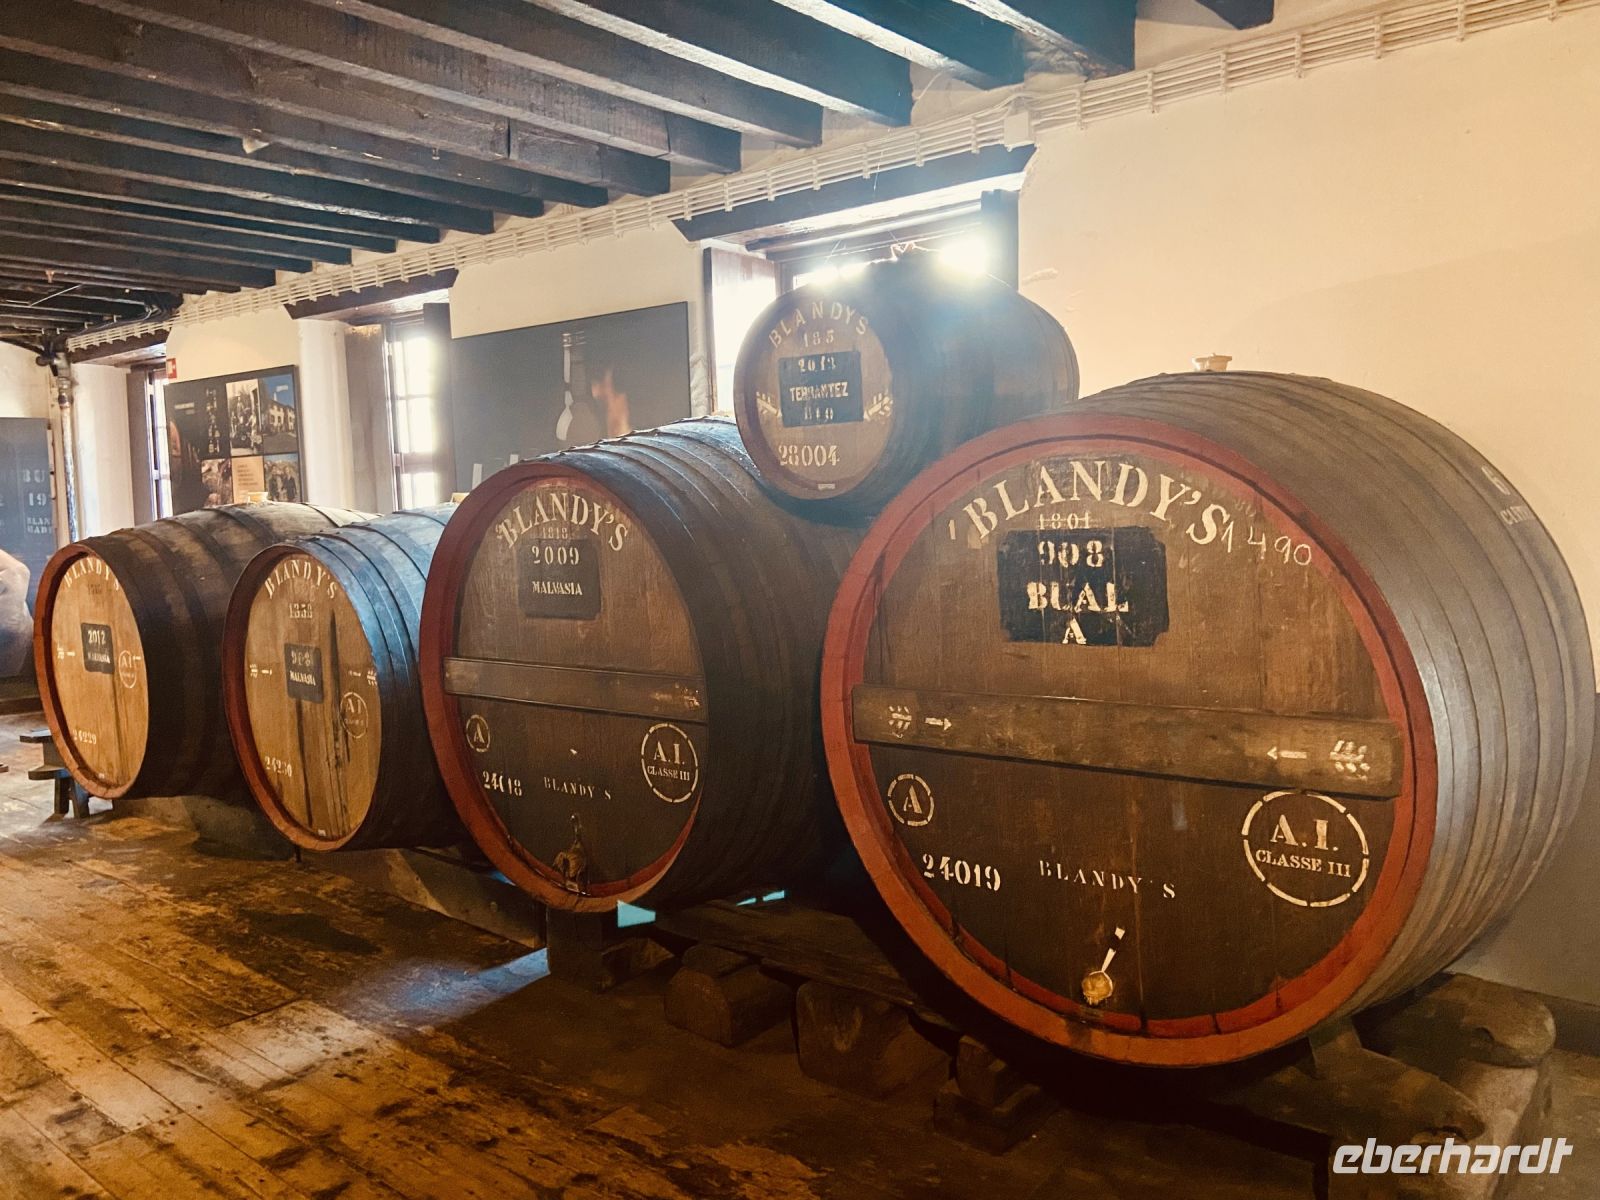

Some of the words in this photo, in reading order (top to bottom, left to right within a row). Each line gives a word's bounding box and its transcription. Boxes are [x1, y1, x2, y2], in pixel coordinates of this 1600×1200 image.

[778, 444, 840, 467] 28004
[963, 460, 1230, 545] BLANDY'S
[500, 492, 629, 551] BLANDY'S
[531, 545, 580, 565] 2009
[264, 559, 337, 599] BLANDY'S
[531, 581, 583, 596] MALVASIA
[1062, 617, 1087, 645] A
[473, 722, 485, 743] A
[903, 785, 923, 814] A
[922, 853, 1001, 892] 24019
[1255, 849, 1322, 873] CLASSE
[1328, 861, 1352, 878] III
